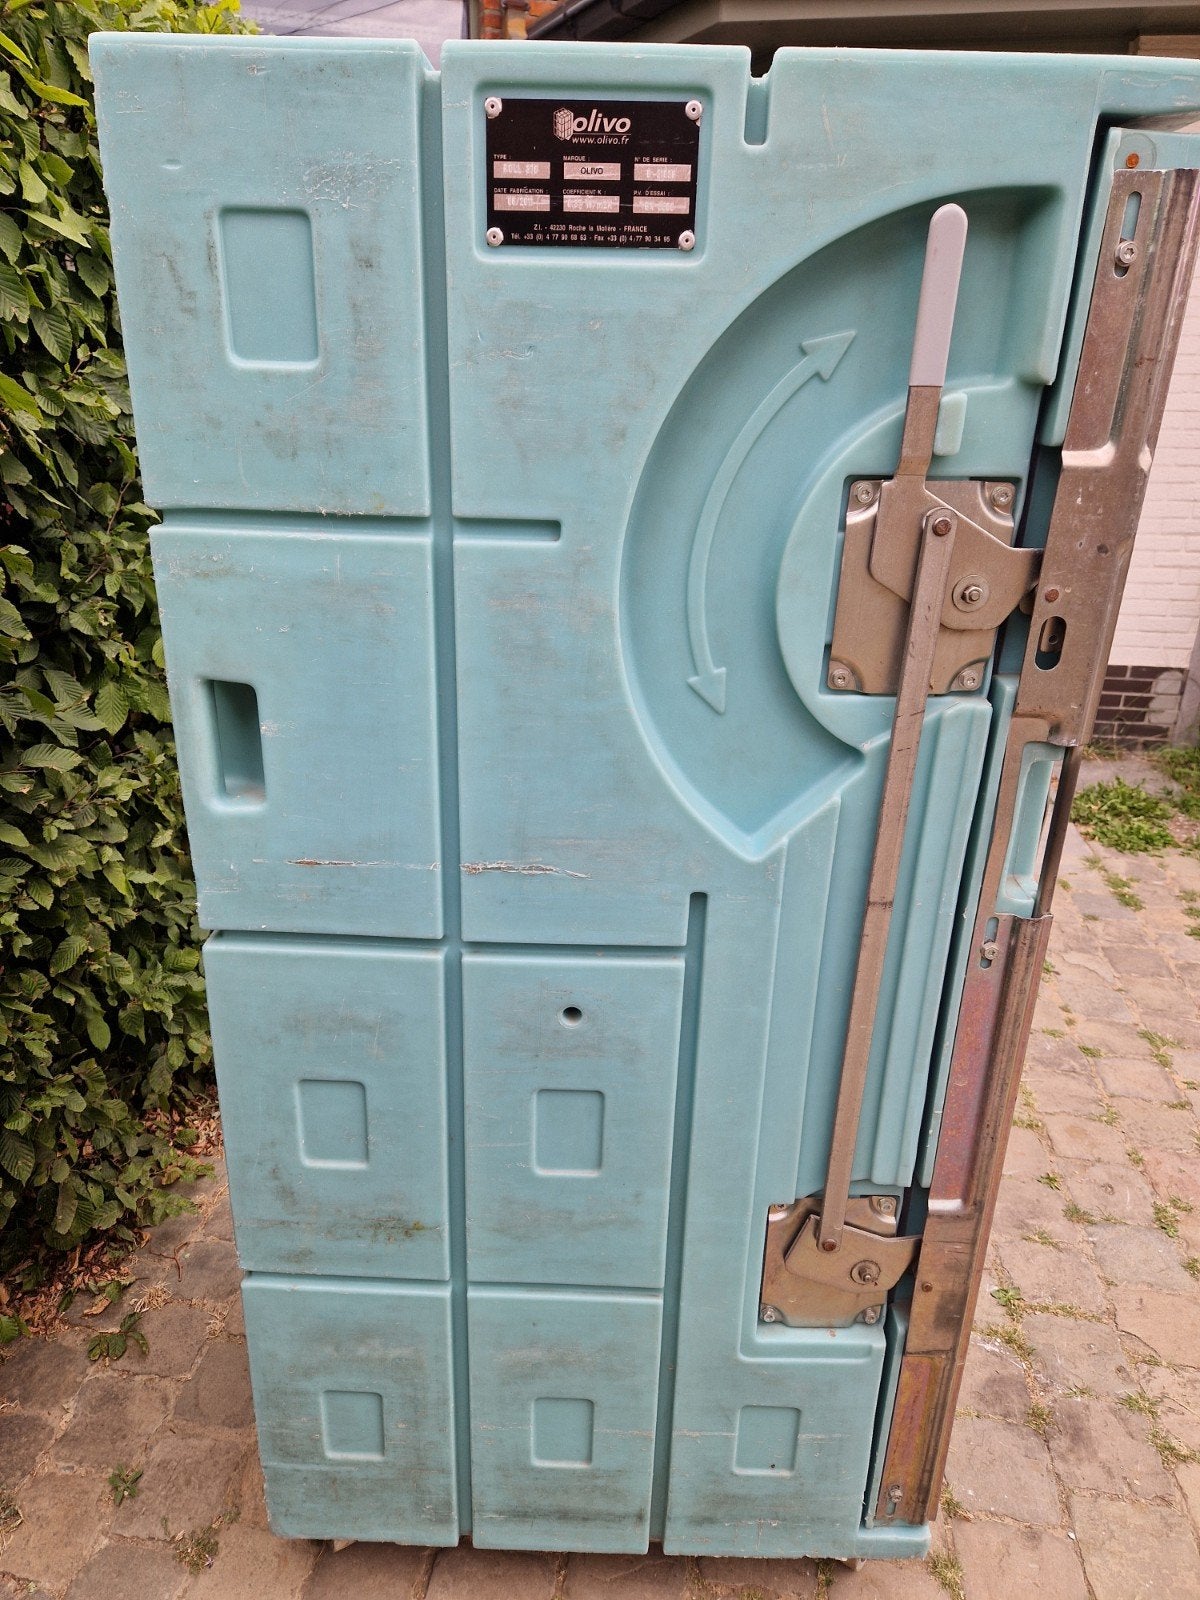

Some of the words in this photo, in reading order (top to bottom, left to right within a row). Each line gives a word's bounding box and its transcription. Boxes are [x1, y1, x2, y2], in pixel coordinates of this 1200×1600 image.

[573, 109, 631, 132] olivo
[572, 135, 630, 145] www.olivo.fr
[580, 166, 604, 175] OLIVO
[549, 224, 566, 232] 42230
[568, 224, 586, 232] Roche
[623, 225, 648, 233] FRANCE
[607, 234, 617, 242] +33
